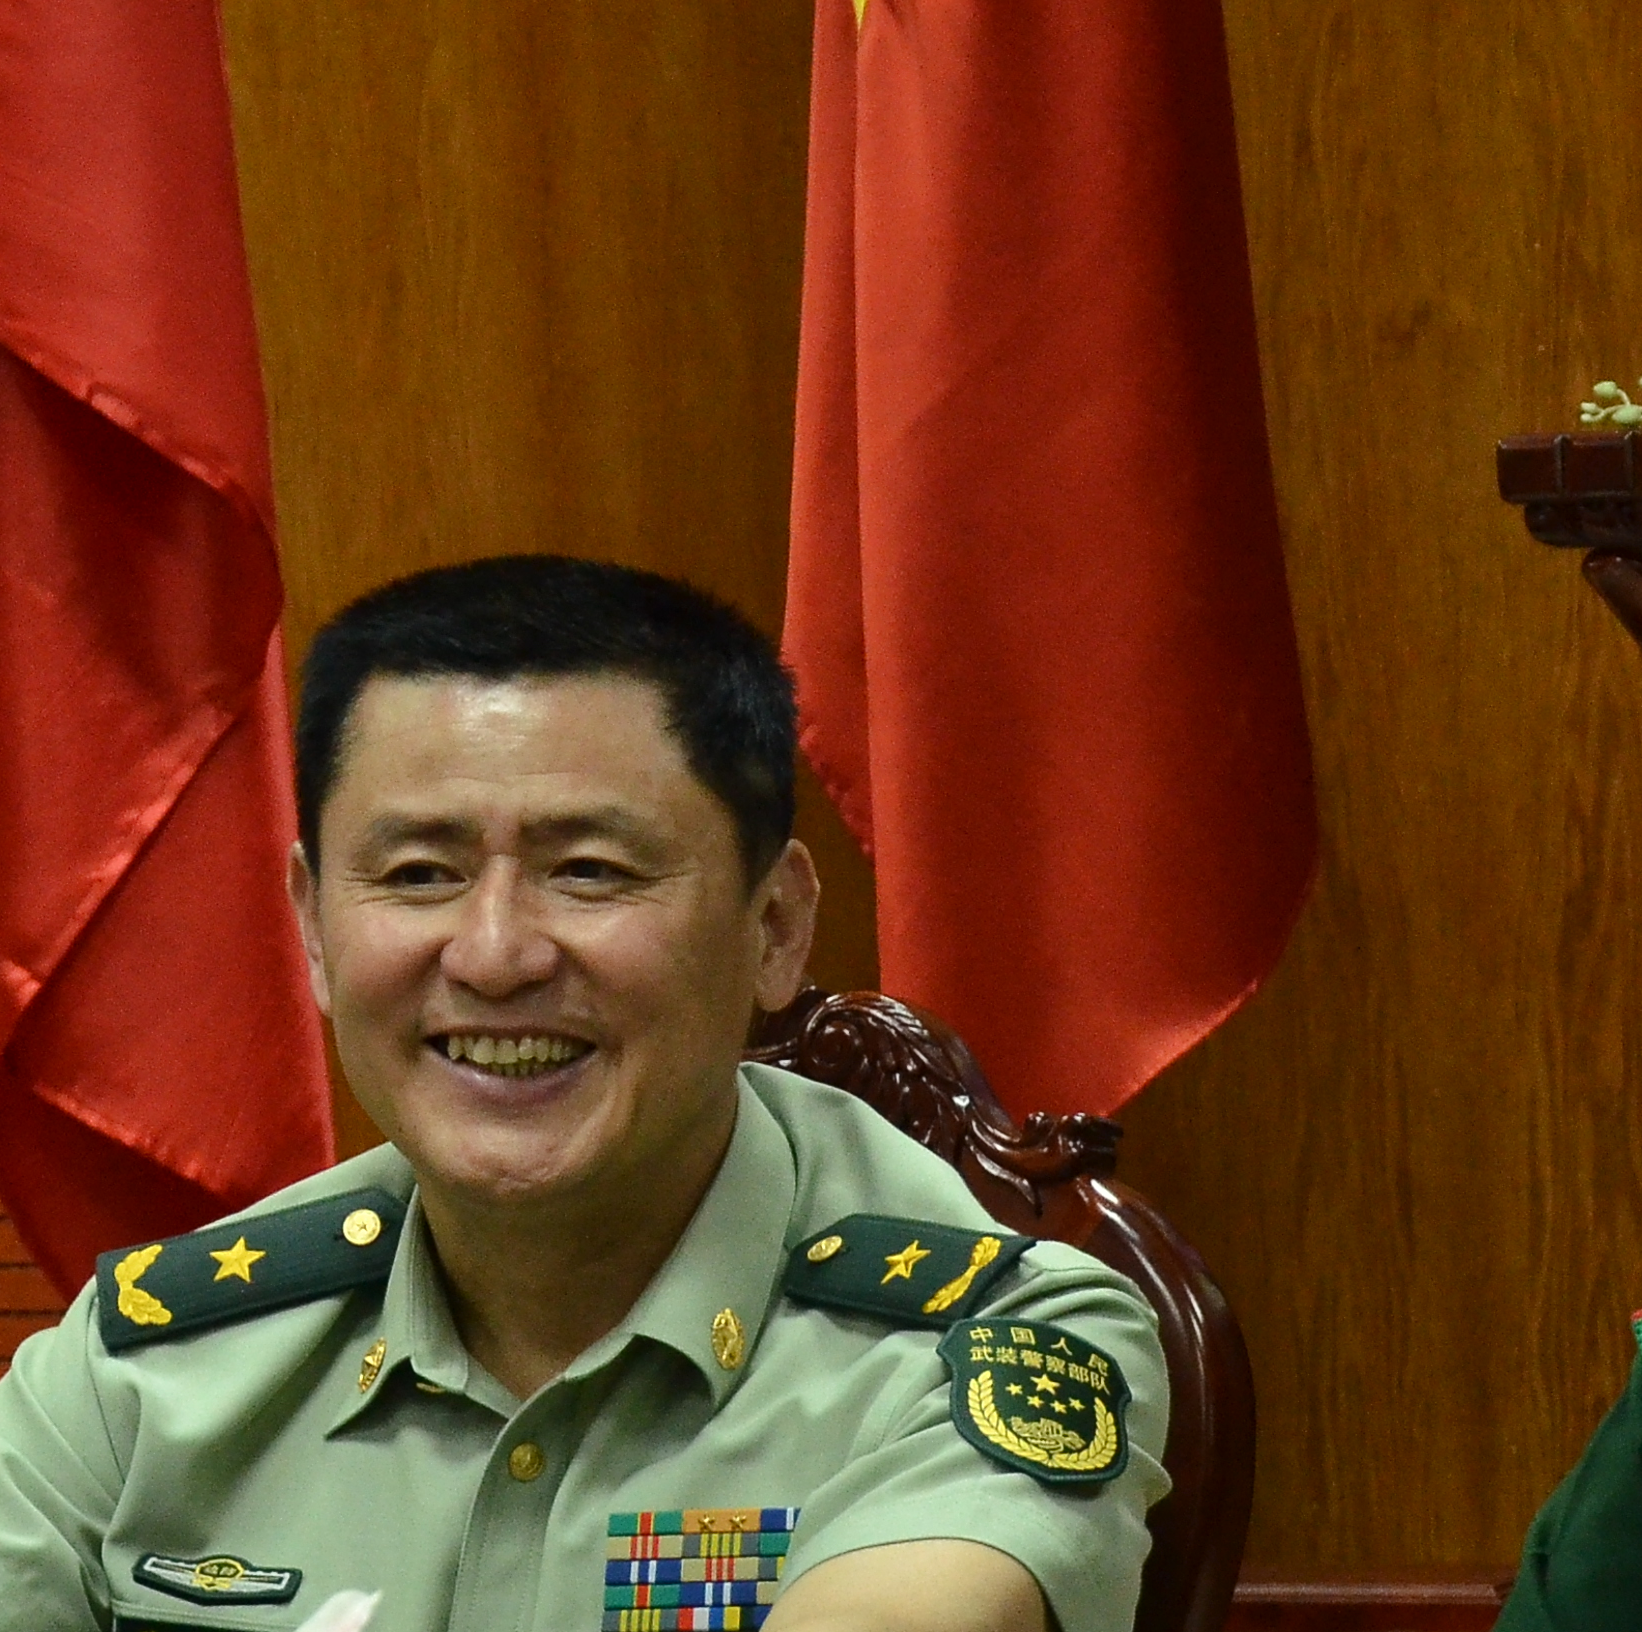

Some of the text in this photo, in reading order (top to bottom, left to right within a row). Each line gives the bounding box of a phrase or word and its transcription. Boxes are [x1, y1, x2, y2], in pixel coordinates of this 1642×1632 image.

[969, 1325, 1109, 1377] 中国人民
[969, 1345, 1111, 1396] 武装警察部队
